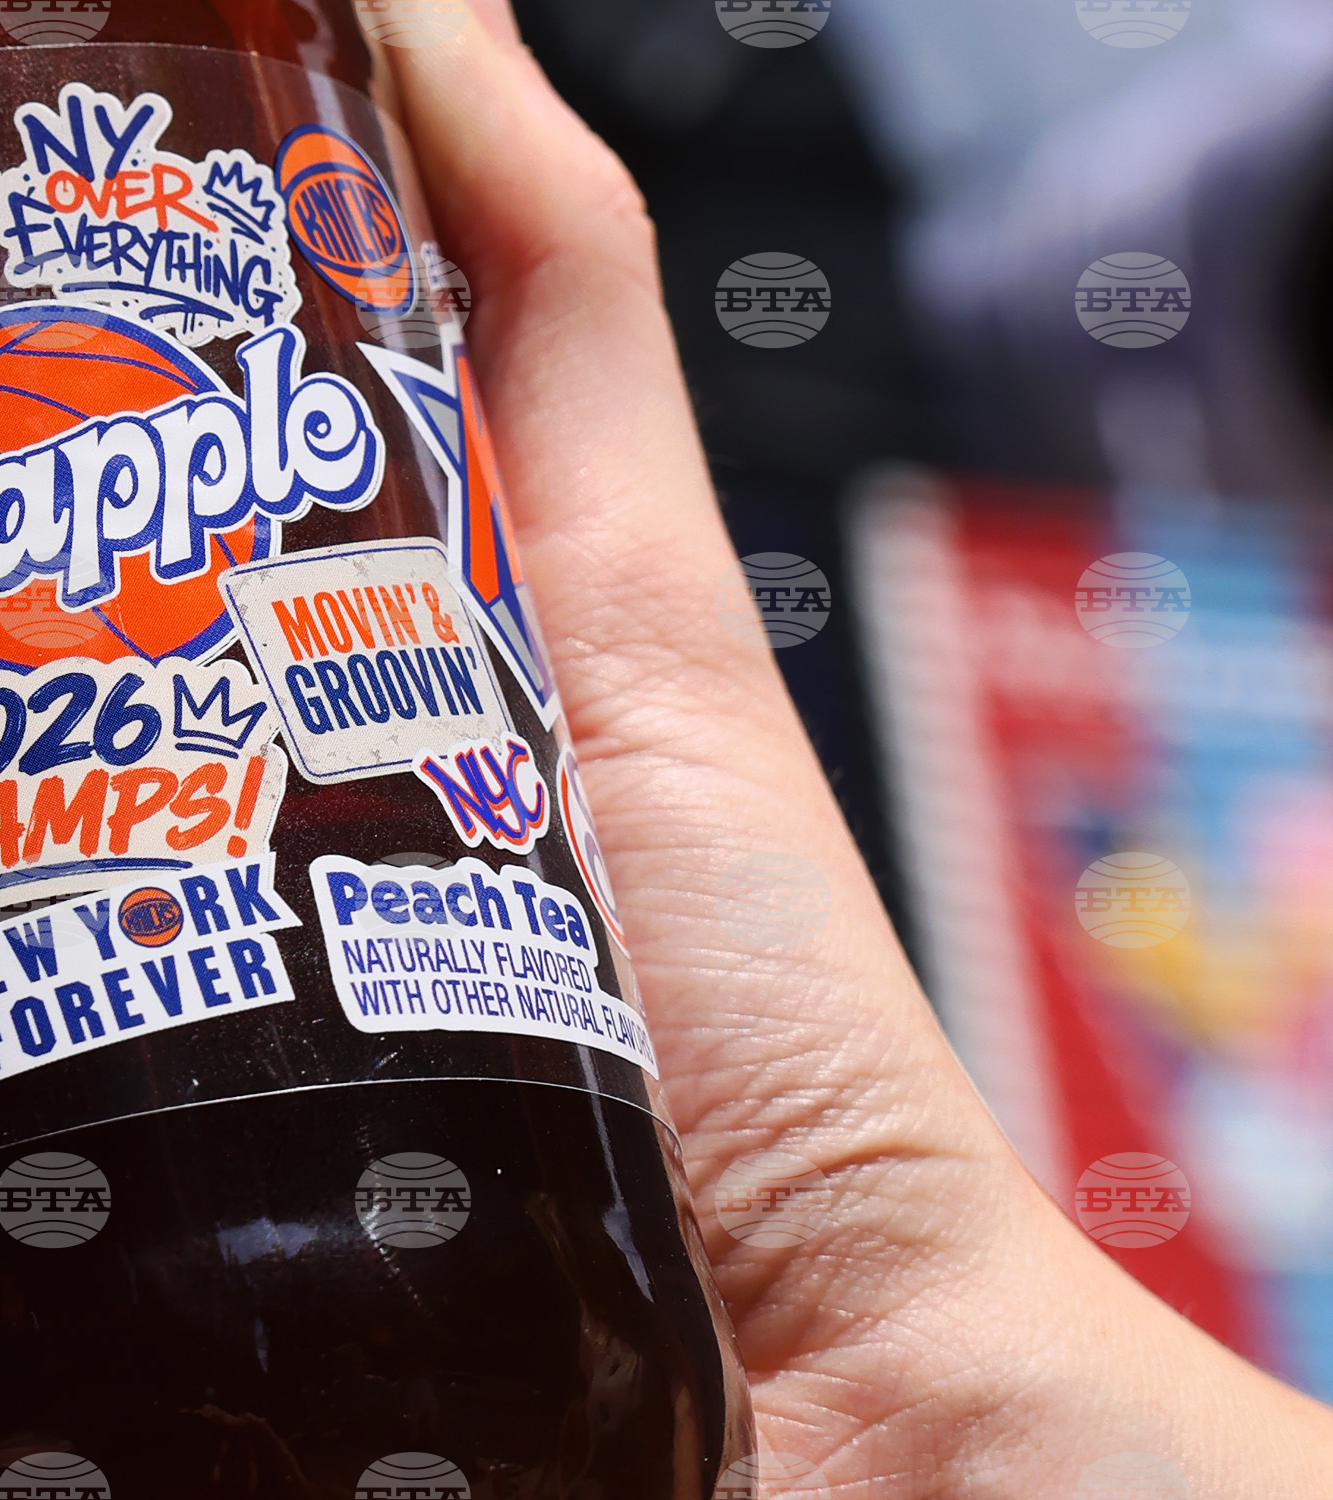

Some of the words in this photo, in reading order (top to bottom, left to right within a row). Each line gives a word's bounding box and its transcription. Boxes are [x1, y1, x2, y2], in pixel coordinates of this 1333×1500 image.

[23, 95, 154, 181] NY
[45, 163, 218, 232] OVER
[295, 177, 397, 271] KNICKS
[271, 582, 417, 662] MOVIN'
[422, 582, 459, 644] &
[284, 646, 485, 735] GROOVIN'
[420, 739, 545, 846] NYC
[326, 871, 512, 931] Peach
[512, 880, 590, 950] Tea
[341, 937, 488, 975] NATURALLY
[494, 942, 593, 994] FLAVORED
[350, 980, 423, 1017] WITH
[431, 979, 515, 1017] OTHER
[517, 985, 604, 1036] NATURAL
